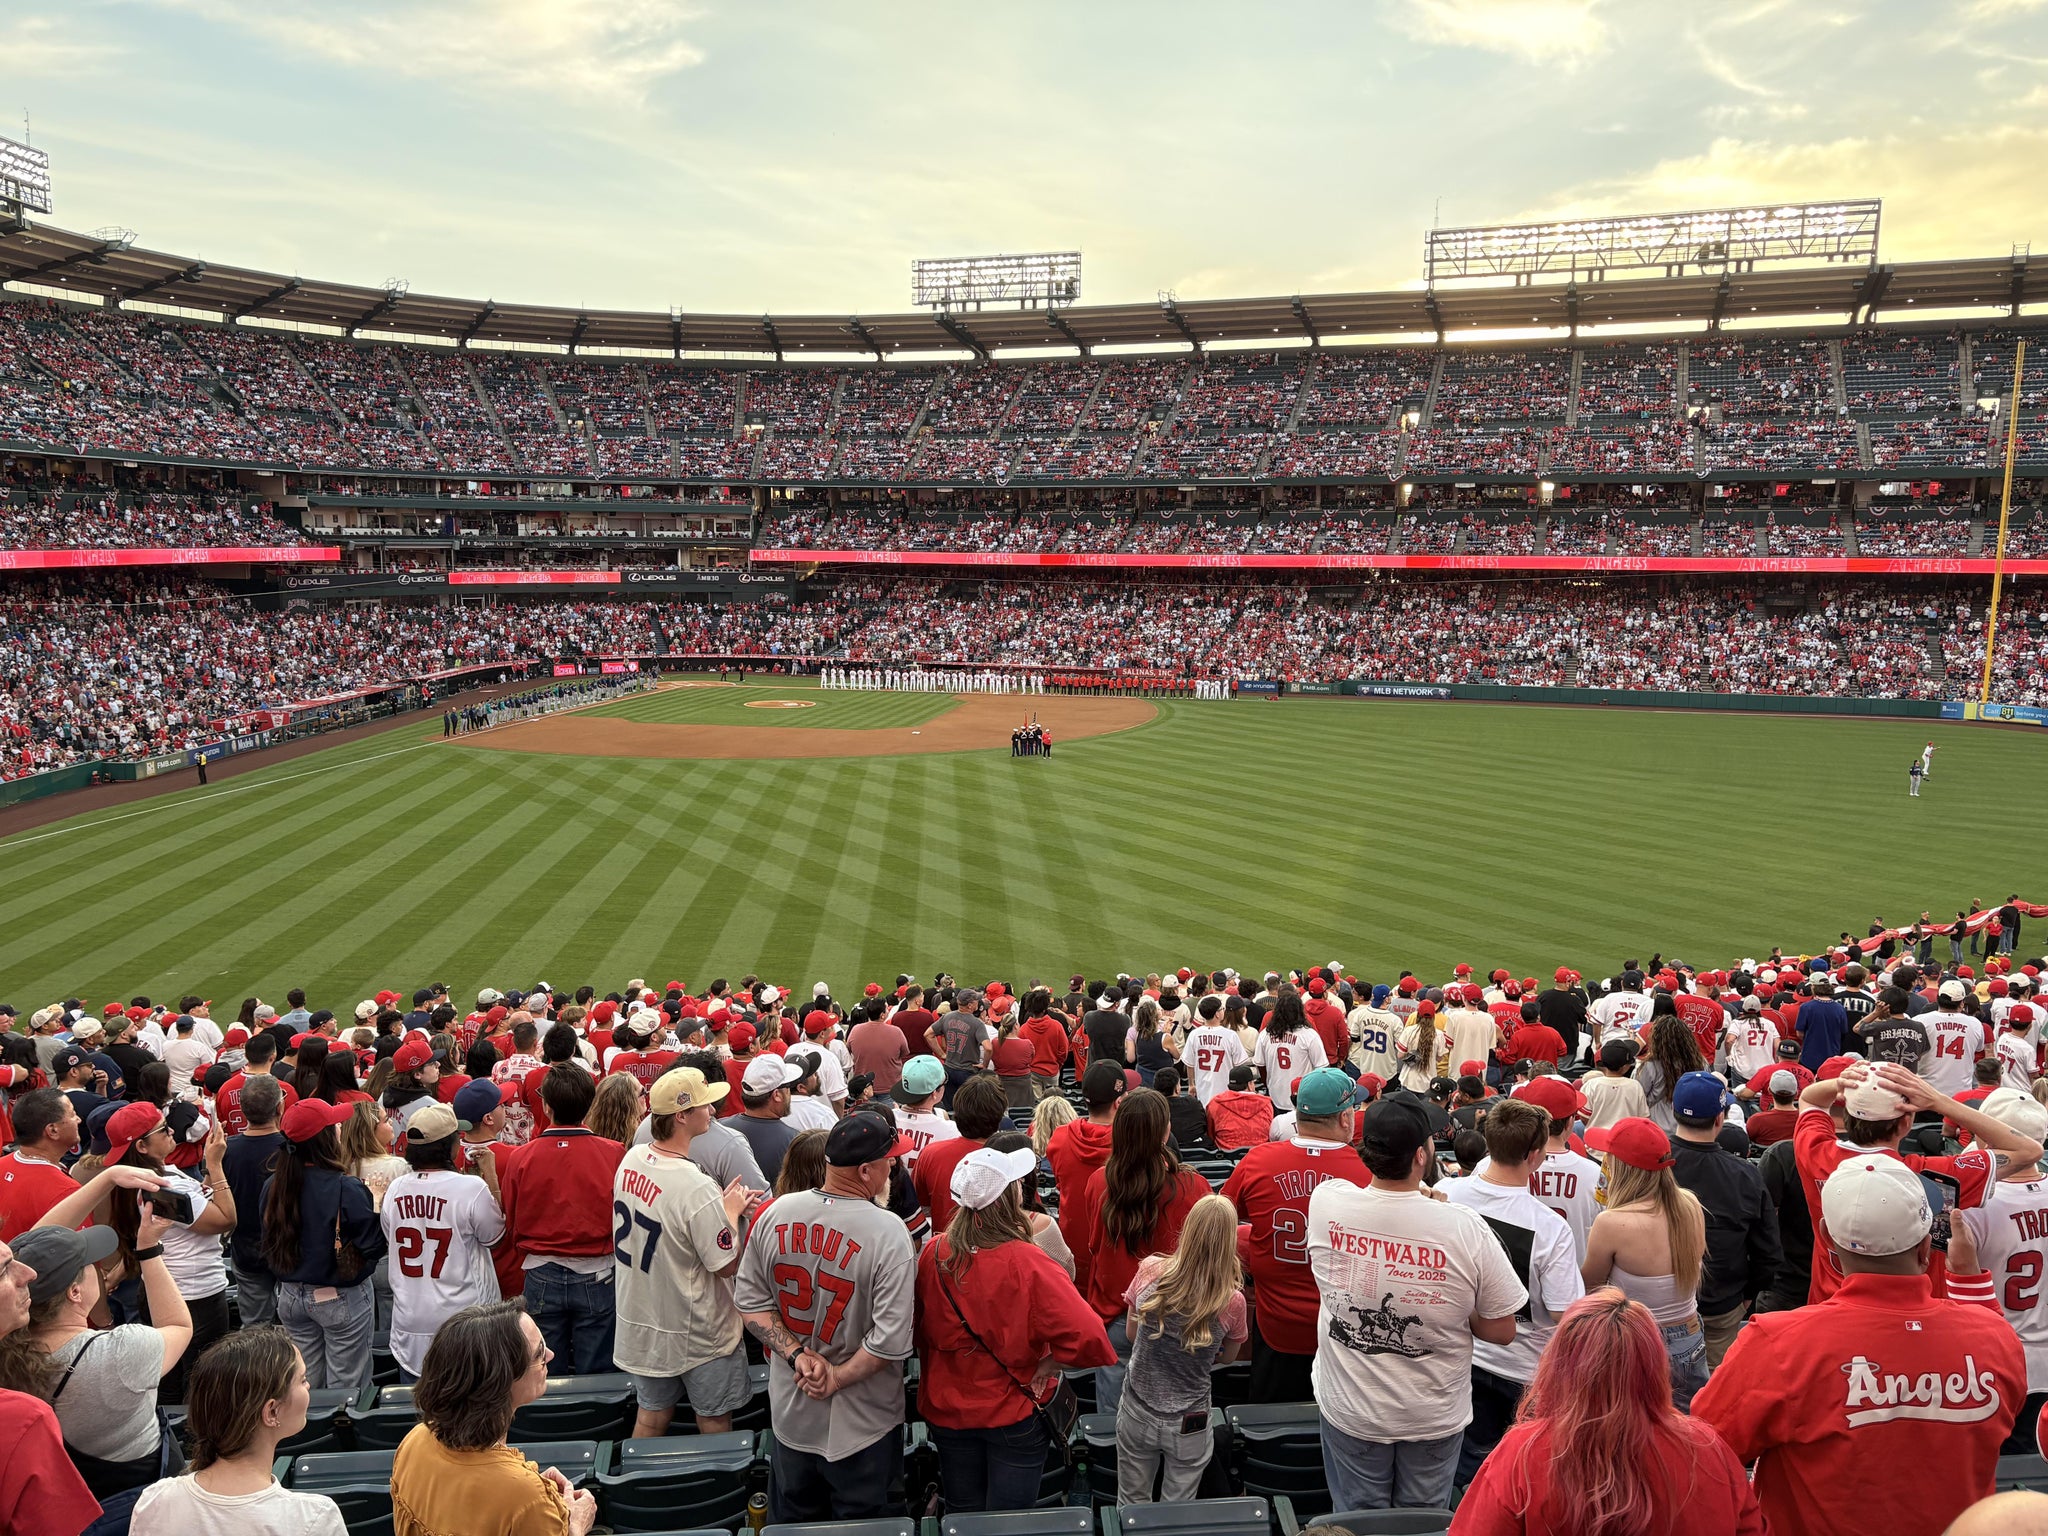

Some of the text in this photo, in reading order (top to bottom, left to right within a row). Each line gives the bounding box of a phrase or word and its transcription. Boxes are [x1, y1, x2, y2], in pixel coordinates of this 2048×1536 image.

[72, 551, 116, 566] ANGELS
[172, 548, 208, 562] ANGELS
[259, 548, 299, 561] ANGELS
[751, 550, 791, 561] NGELS
[856, 551, 902, 563] ANGELS
[966, 552, 1013, 564] ANGELS
[1068, 554, 1117, 566] ANGELS
[1188, 554, 1241, 567] ANGELS
[1318, 554, 1373, 567] ANGELS
[1440, 556, 1499, 568] ANGELS
[1584, 557, 1648, 570] ANGELS
[1738, 558, 1808, 571] ANGELS
[1888, 559, 1962, 573] ANGELS
[1122, 668, 1156, 676] SALINAS,
[1373, 686, 1434, 696] MLB NETWORK
[2001, 707, 2015, 716] 811
[237, 737, 254, 751] Modelo
[156, 758, 182, 769] FMB.com
[1620, 1001, 1640, 1011] TROUT
[1684, 1003, 1714, 1015] TROUT
[1362, 1018, 1390, 1031] RALEIGH
[1682, 1012, 1713, 1034] 27
[1935, 1021, 1968, 1034] O'HOPPE
[946, 1031, 968, 1055] 27
[1197, 1034, 1223, 1047] TROUT
[1363, 1029, 1388, 1054] 29
[1747, 1030, 1769, 1047] 27
[1935, 1033, 1966, 1060] 14
[1197, 1049, 1226, 1073] 27
[1277, 1047, 1292, 1070] 6
[625, 1063, 663, 1078] TROUT
[622, 1168, 663, 1208] TROUT
[1529, 1171, 1578, 1199] NETO
[394, 1194, 448, 1222] TROUT
[1328, 1220, 1344, 1232] The
[613, 1199, 663, 1275] 27
[395, 1226, 453, 1279] 27
[774, 1222, 862, 1271] TROUT
[1328, 1230, 1447, 1269] WESTWARD
[1384, 1264, 1447, 1282] Tour 2025
[773, 1262, 855, 1345] 27
[1844, 1355, 2000, 1418] Angels
